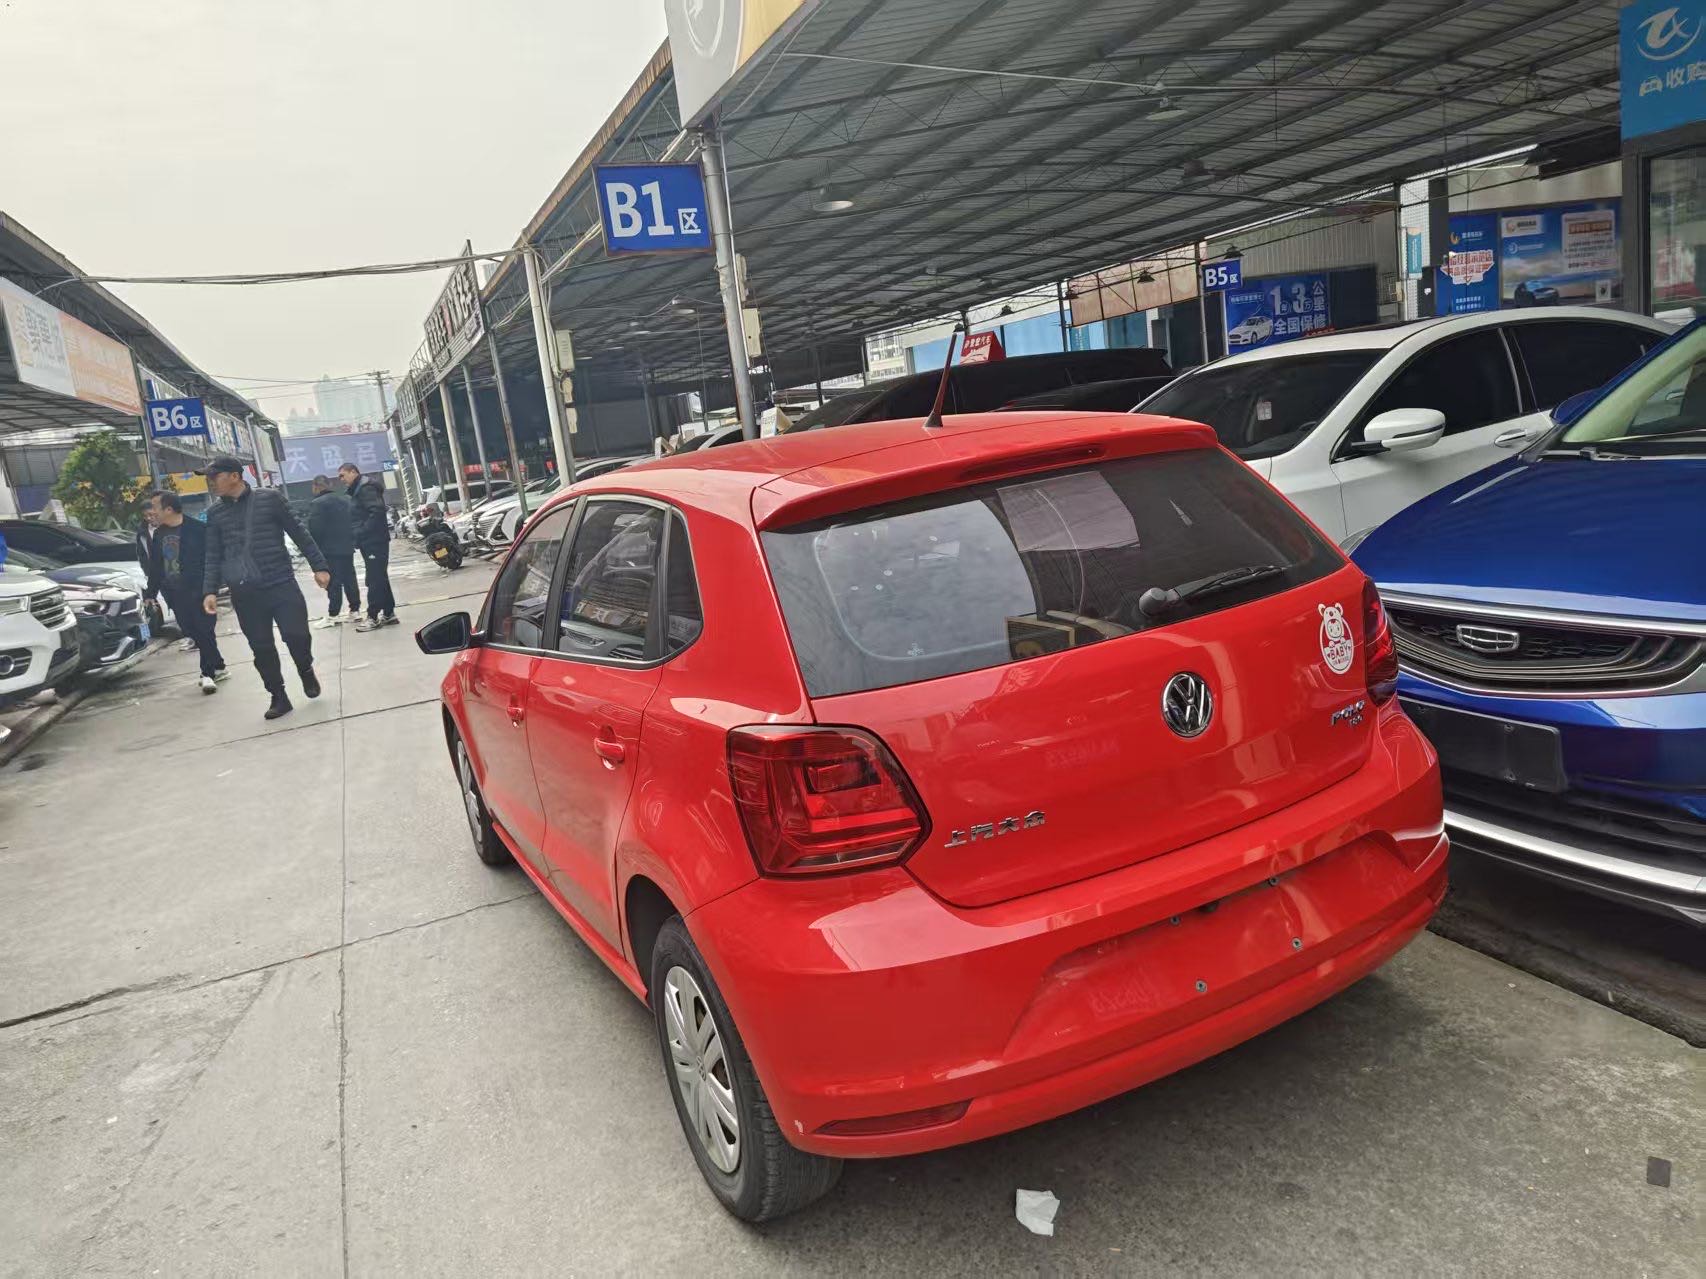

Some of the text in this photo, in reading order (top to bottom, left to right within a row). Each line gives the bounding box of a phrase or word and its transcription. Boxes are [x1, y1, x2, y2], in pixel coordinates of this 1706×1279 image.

[606, 181, 701, 238] B1区
[1205, 267, 1239, 287] B5区
[1274, 313, 1326, 335] 全国保修
[151, 405, 202, 432] B6区
